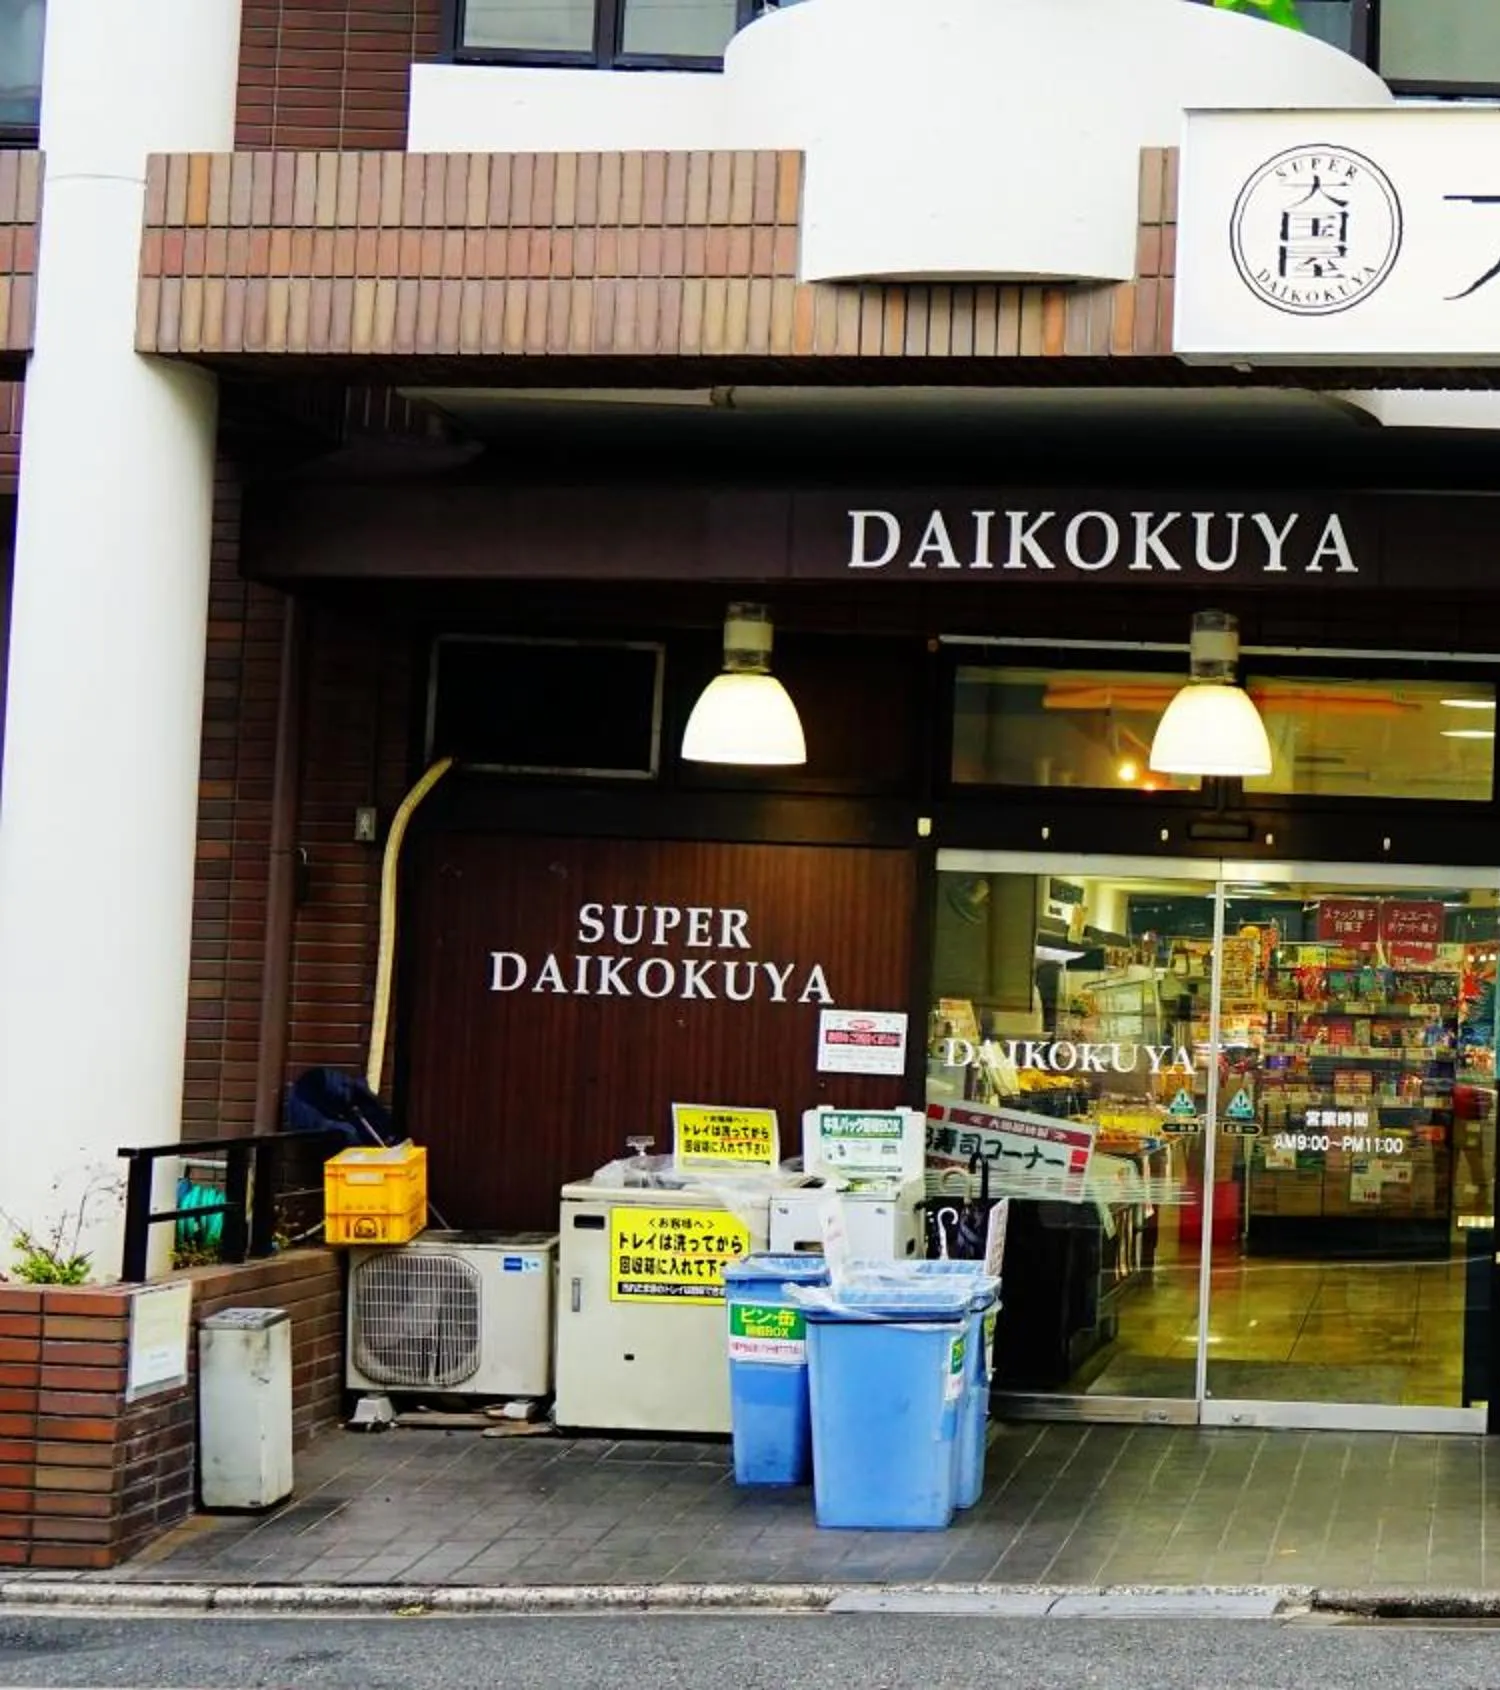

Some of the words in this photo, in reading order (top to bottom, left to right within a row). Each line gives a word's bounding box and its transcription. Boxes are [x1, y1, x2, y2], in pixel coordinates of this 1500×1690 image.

[1275, 157, 1359, 180] SUPER
[1278, 174, 1352, 279] 大国屋
[849, 511, 1358, 571] DAIKOKUYA
[578, 902, 752, 949] SUPER
[490, 952, 834, 1004] DAIKOKUYA
[944, 1038, 1198, 1076] DAIKOKUYA
[683, 1123, 769, 1139] トレイは洗ってから
[1305, 1110, 1369, 1127] 営業時間
[619, 1231, 744, 1254] トレイは洗ってから
